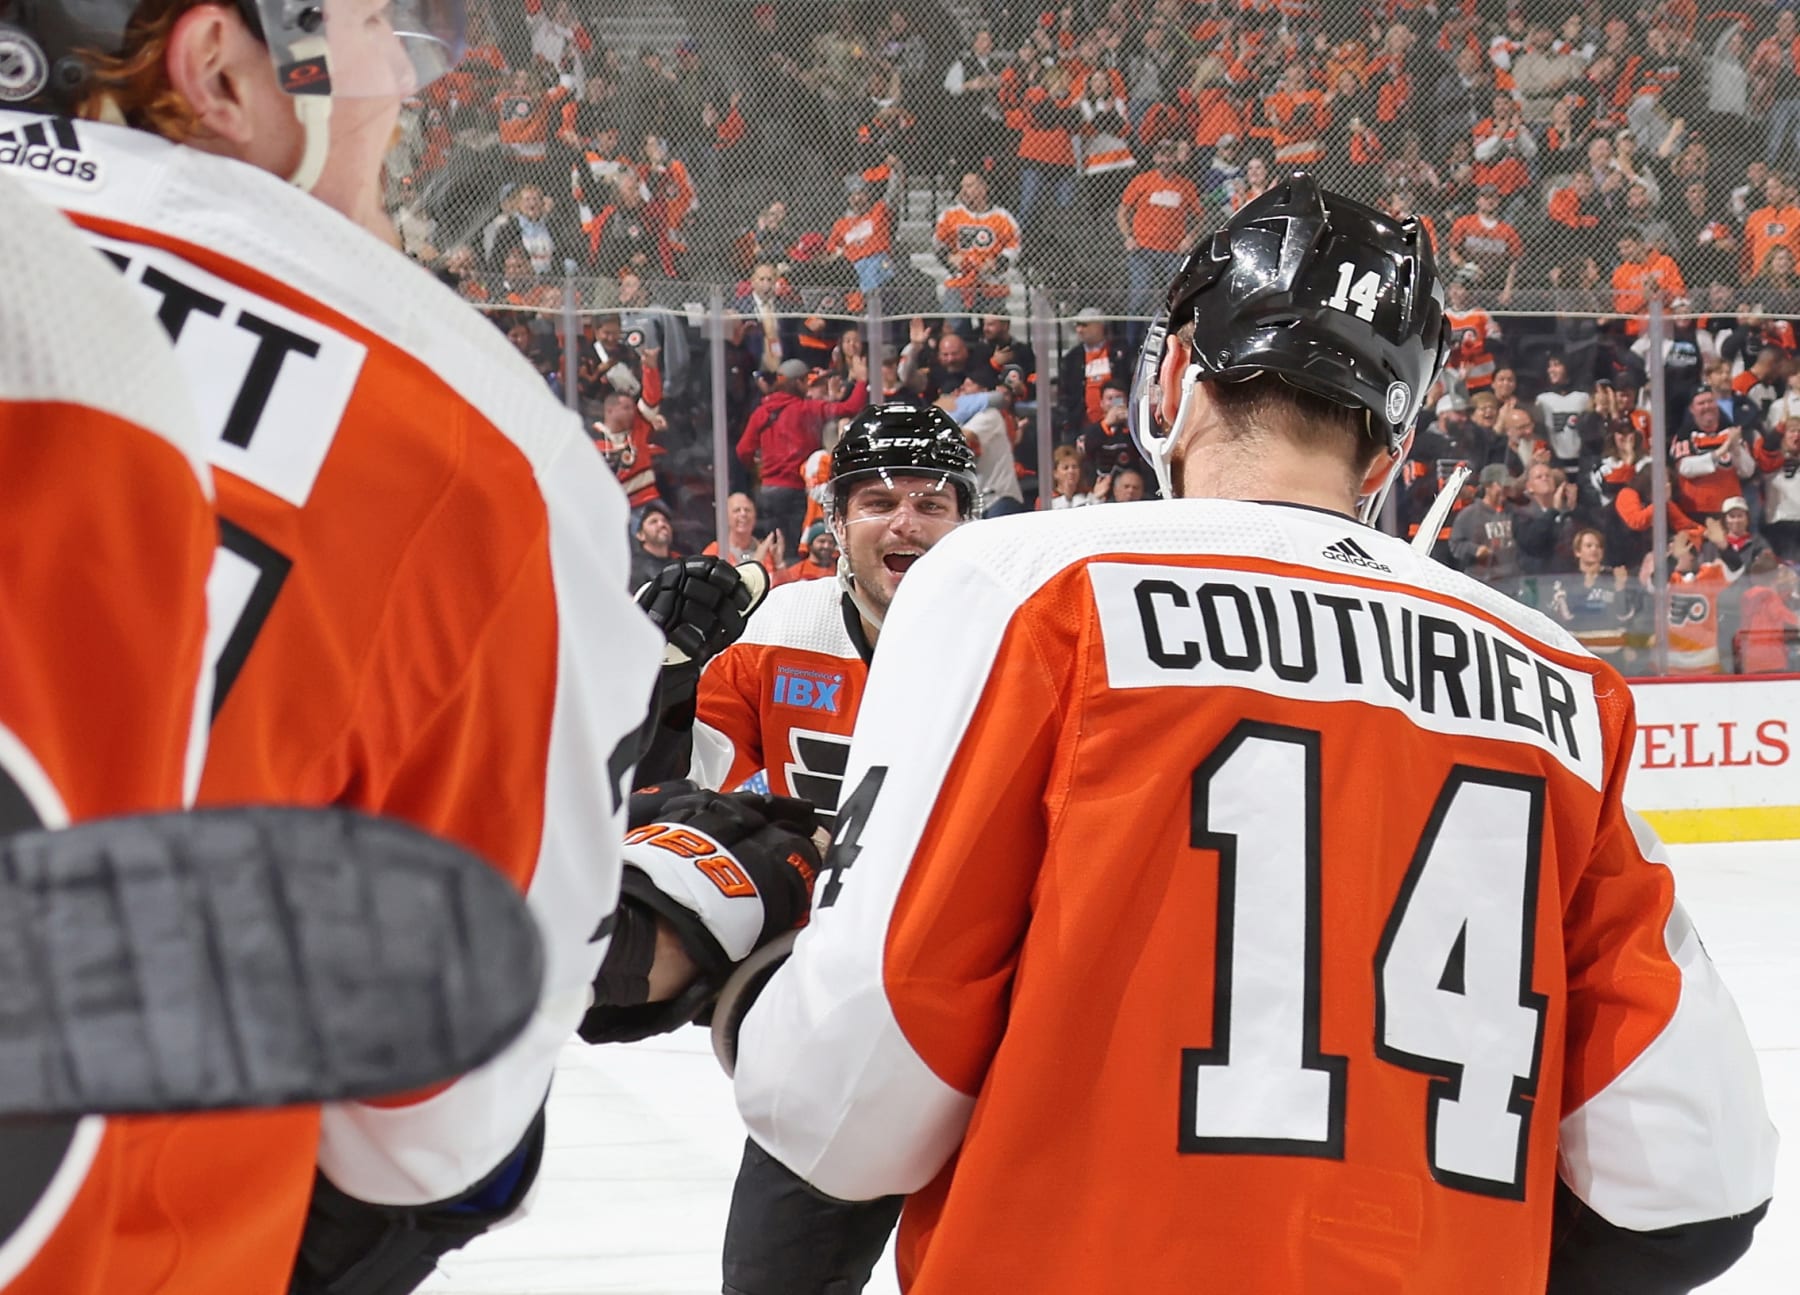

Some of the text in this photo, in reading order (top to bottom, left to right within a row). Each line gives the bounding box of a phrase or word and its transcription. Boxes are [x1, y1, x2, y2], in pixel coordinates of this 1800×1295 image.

[1328, 261, 1381, 323] 14
[92, 247, 322, 451] TT
[876, 437, 930, 448] CCM
[1322, 551, 1392, 573] adidas
[773, 675, 840, 712] IBX
[1134, 579, 1581, 761] COUTURIER
[1637, 719, 1790, 769] ELLS
[1177, 718, 1549, 1202] 14
